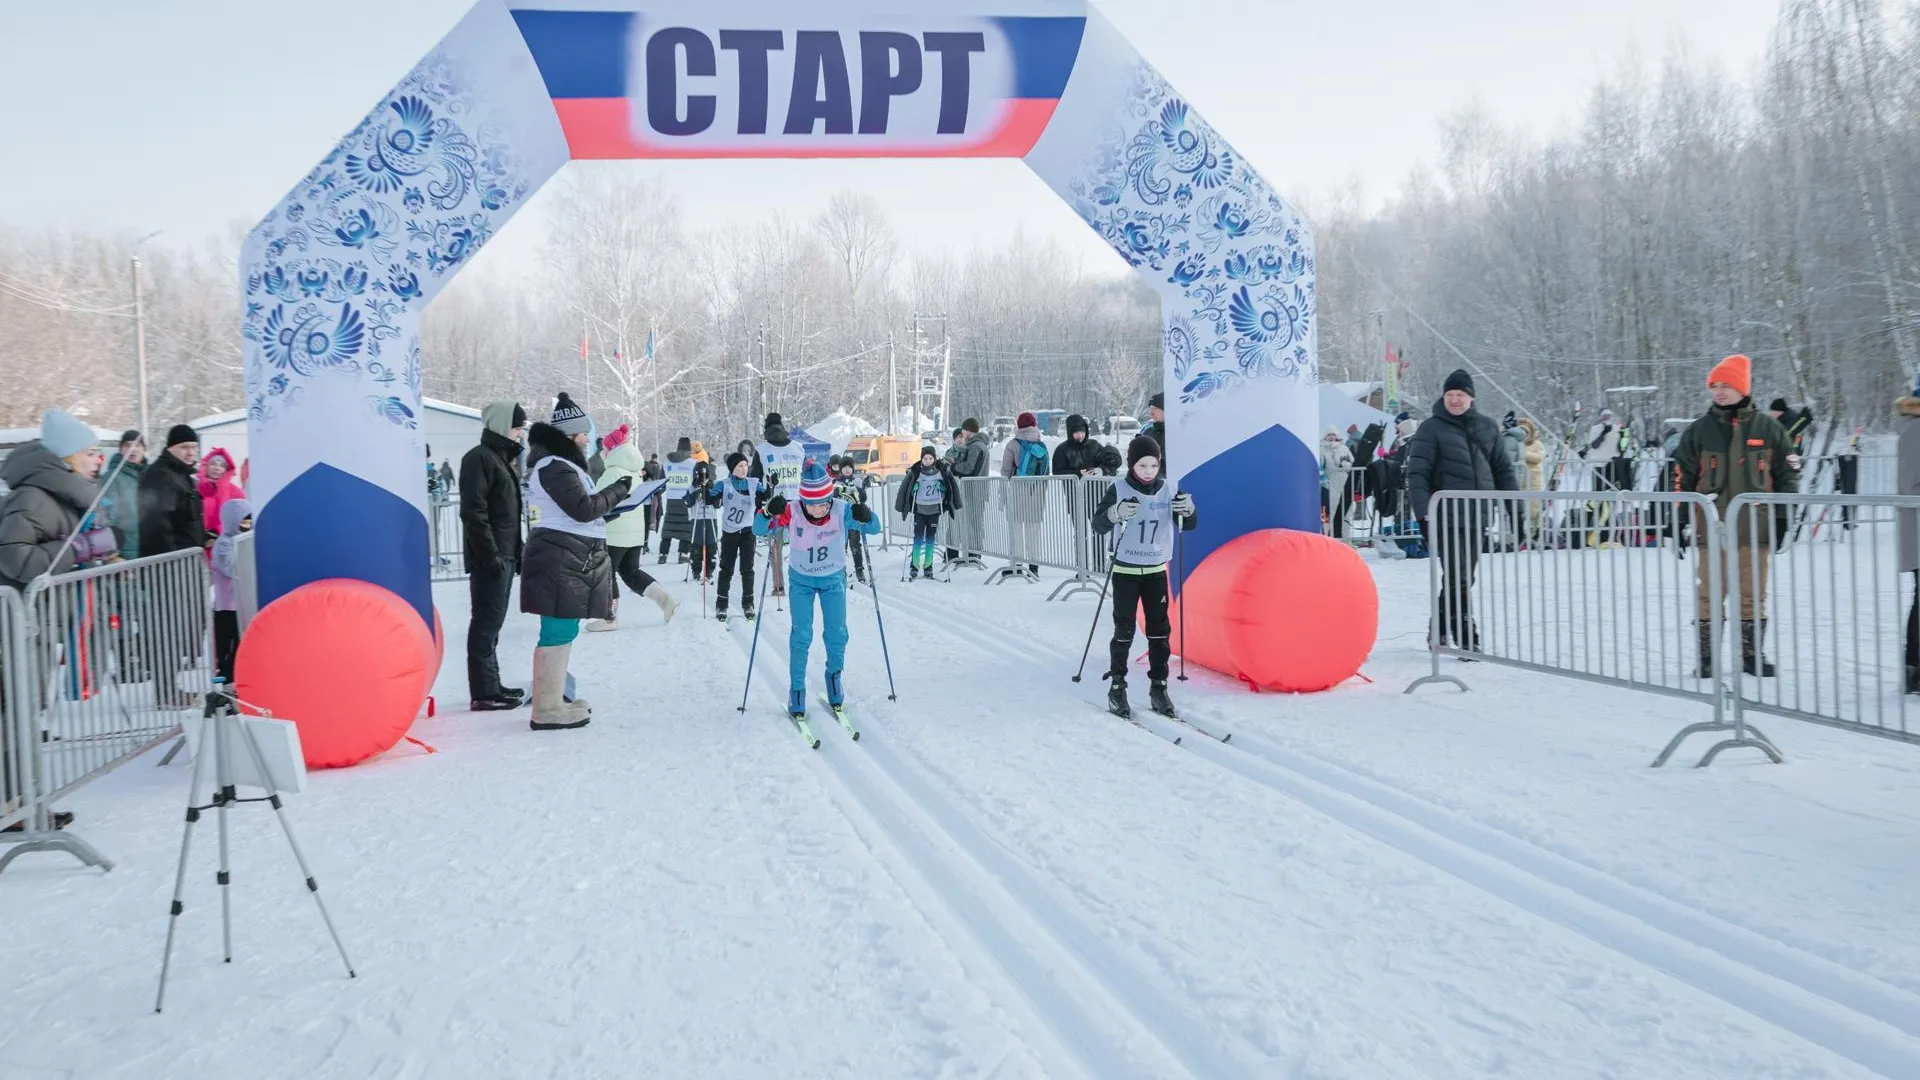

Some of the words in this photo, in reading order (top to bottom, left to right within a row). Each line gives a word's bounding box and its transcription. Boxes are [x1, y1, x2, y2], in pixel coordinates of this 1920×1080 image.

[645, 25, 986, 137] СТАРТ
[727, 506, 745, 525] 20
[1137, 519, 1159, 545] 17
[807, 546, 829, 564] 18
